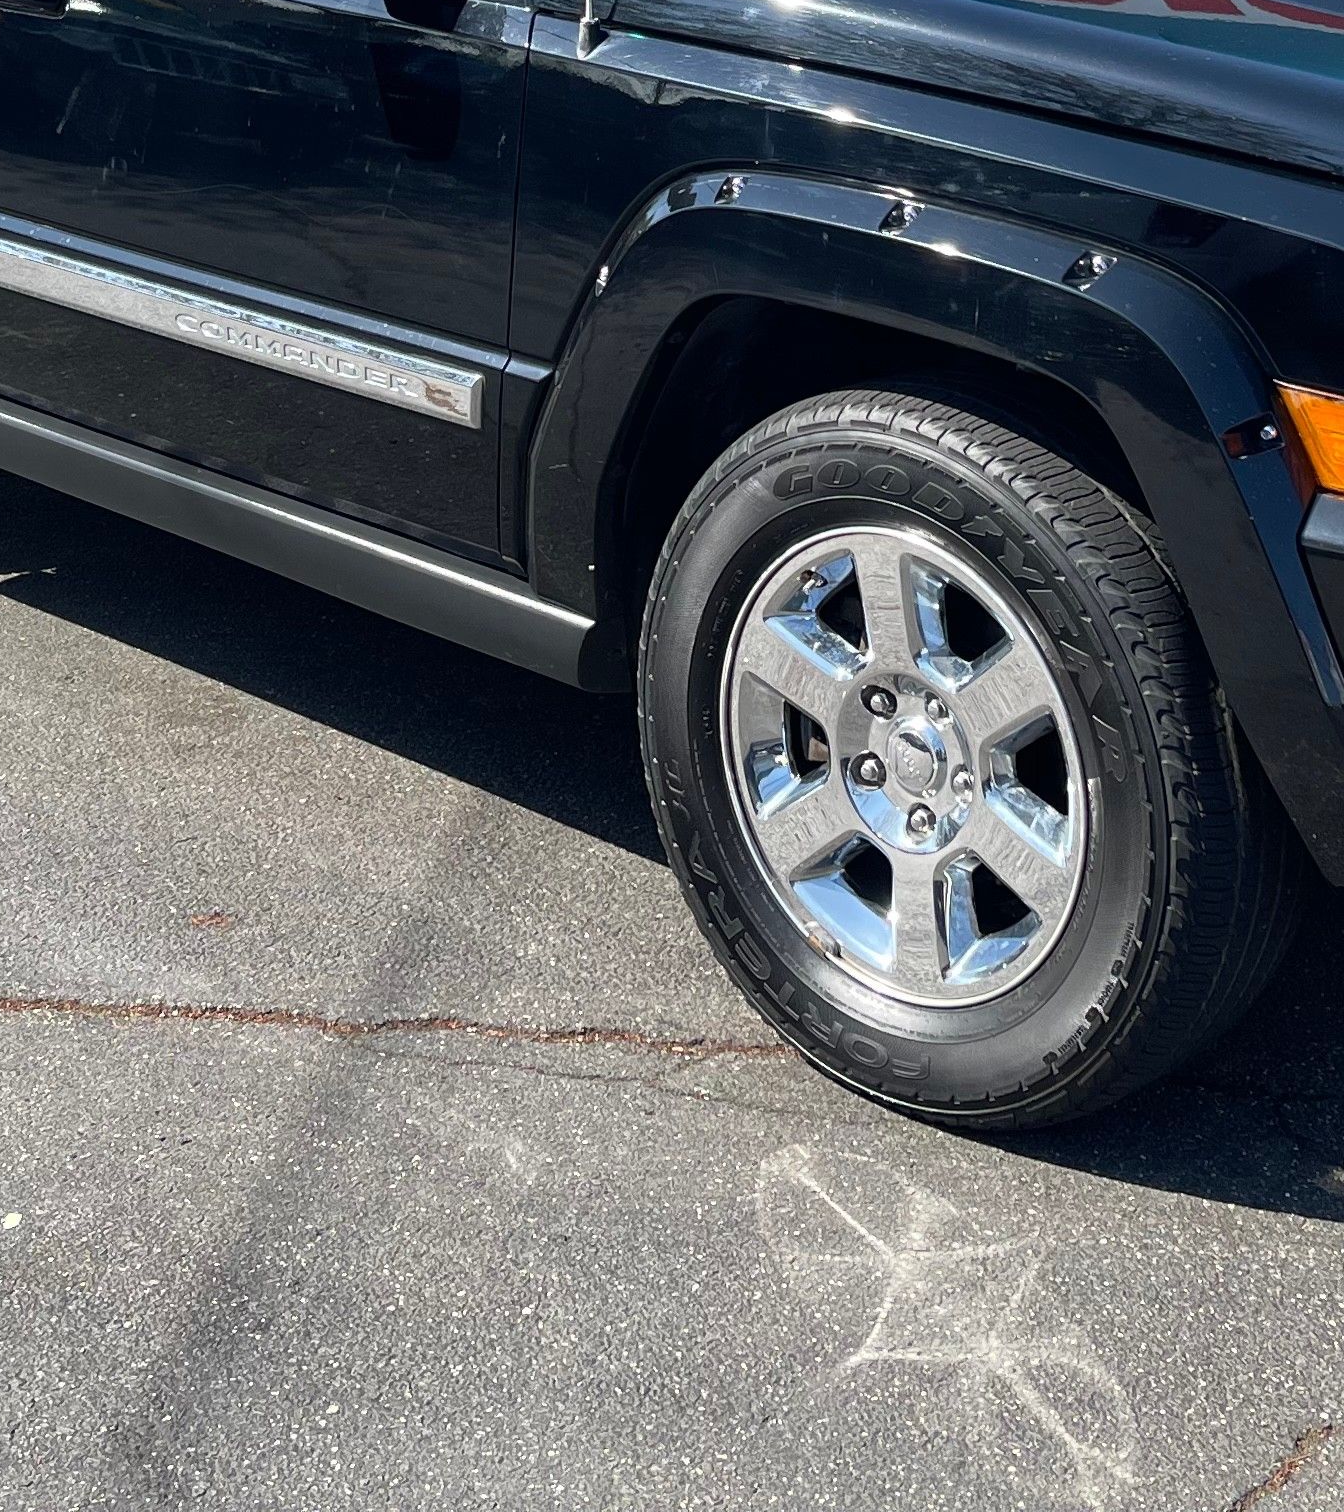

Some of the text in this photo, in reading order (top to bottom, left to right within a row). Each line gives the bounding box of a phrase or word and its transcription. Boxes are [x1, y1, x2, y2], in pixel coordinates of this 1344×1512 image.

[174, 312, 419, 398] COMMANDER
[772, 458, 1130, 783] GOODYEAR
[688, 830, 932, 1081] FORTERA
